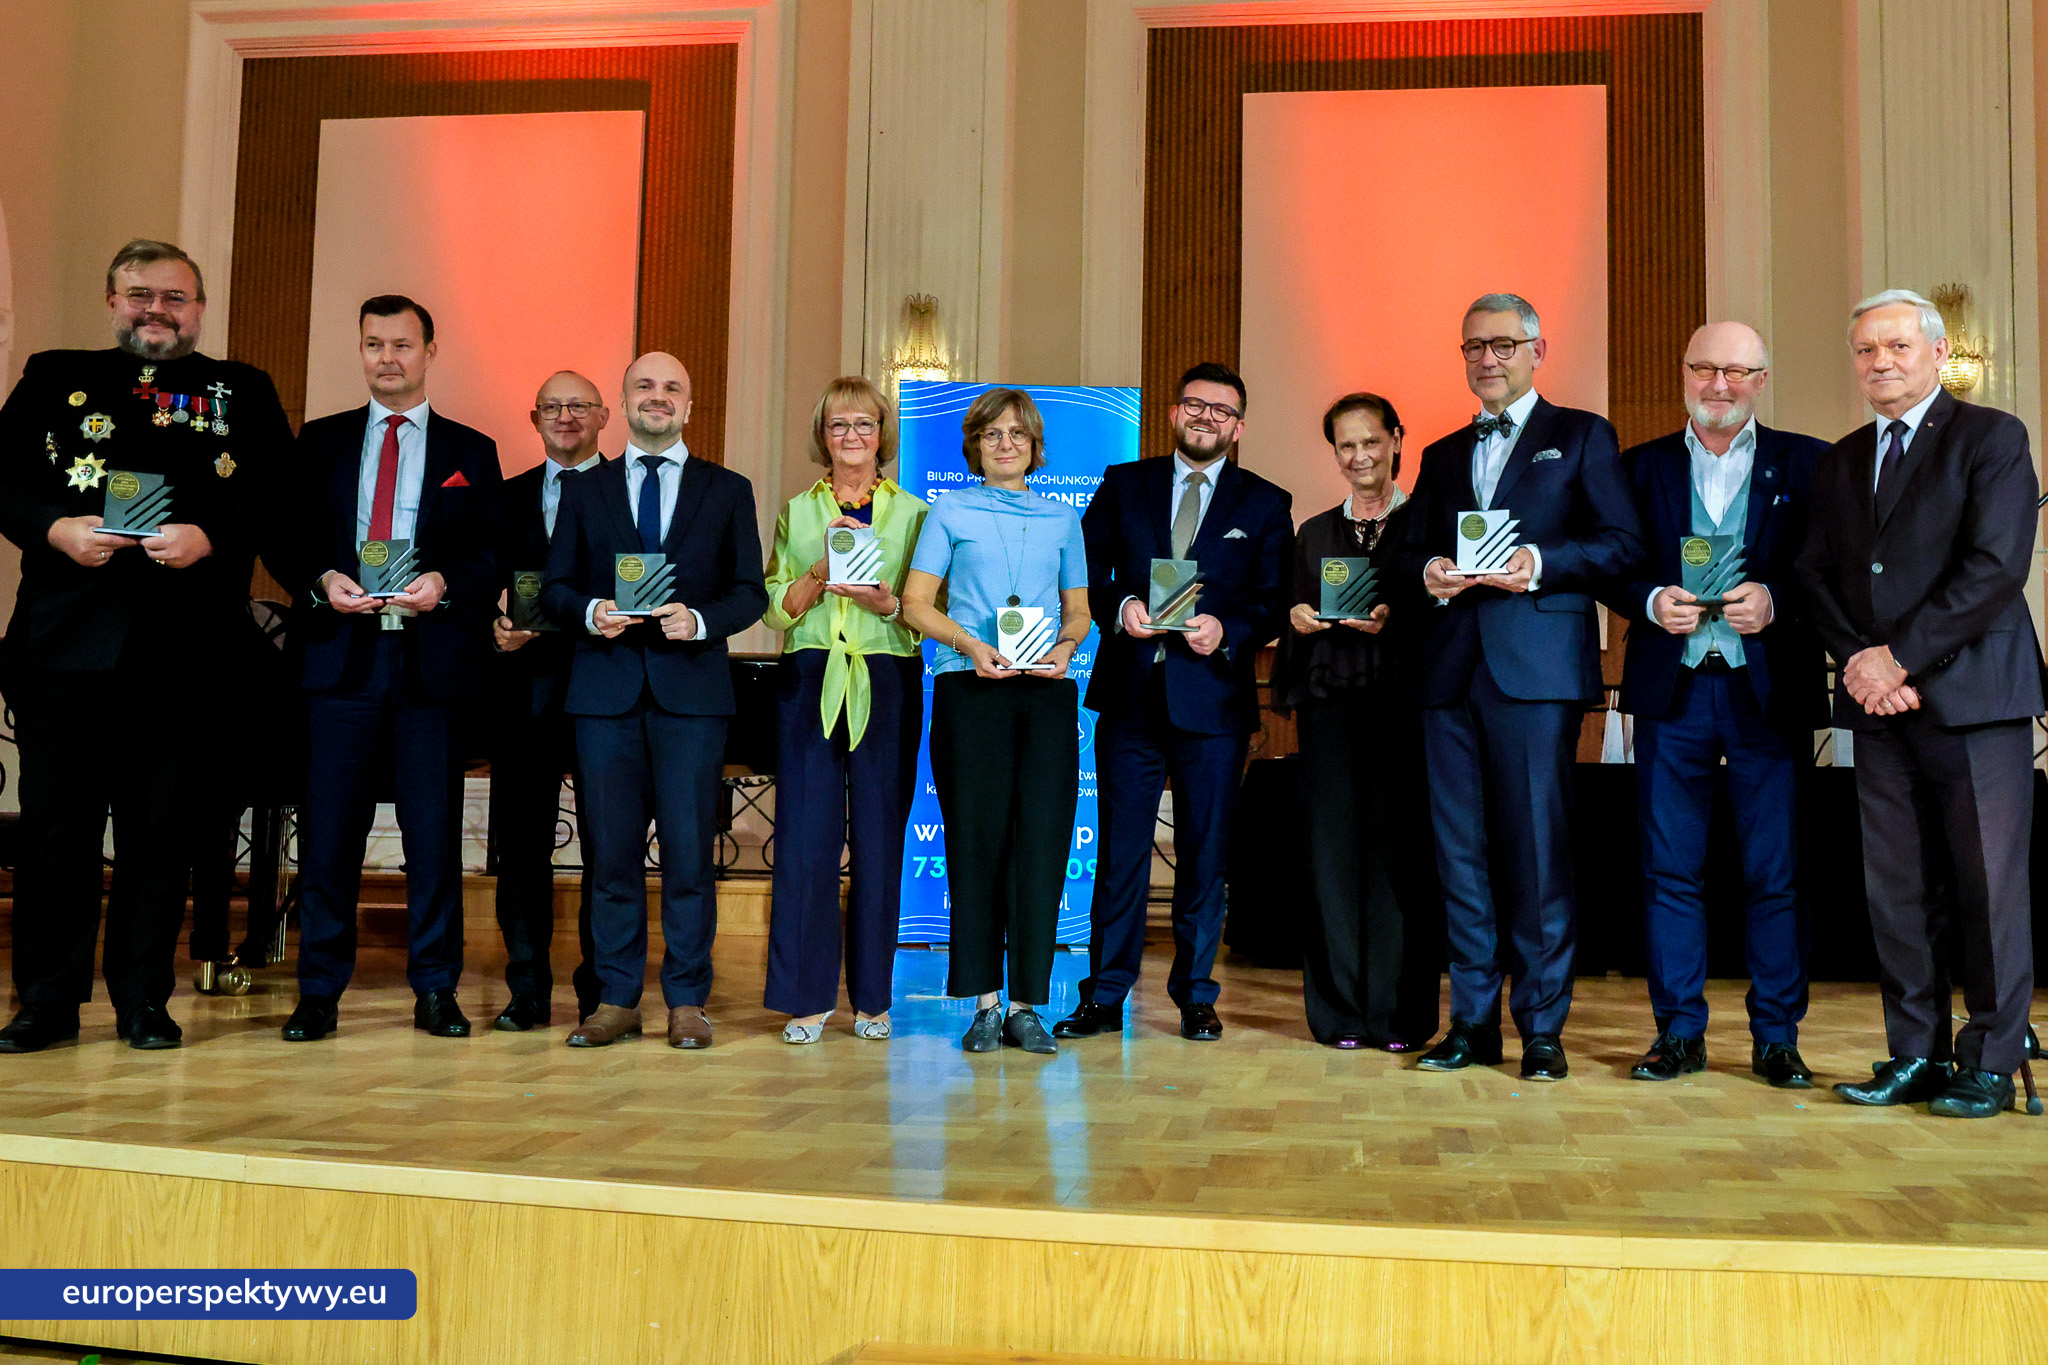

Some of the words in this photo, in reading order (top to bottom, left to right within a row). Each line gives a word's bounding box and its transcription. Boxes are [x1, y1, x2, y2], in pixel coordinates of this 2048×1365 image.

[927, 471, 964, 482] BIURO
[1024, 475, 1105, 485] RACHUNKOW
[912, 856, 947, 878] 73
